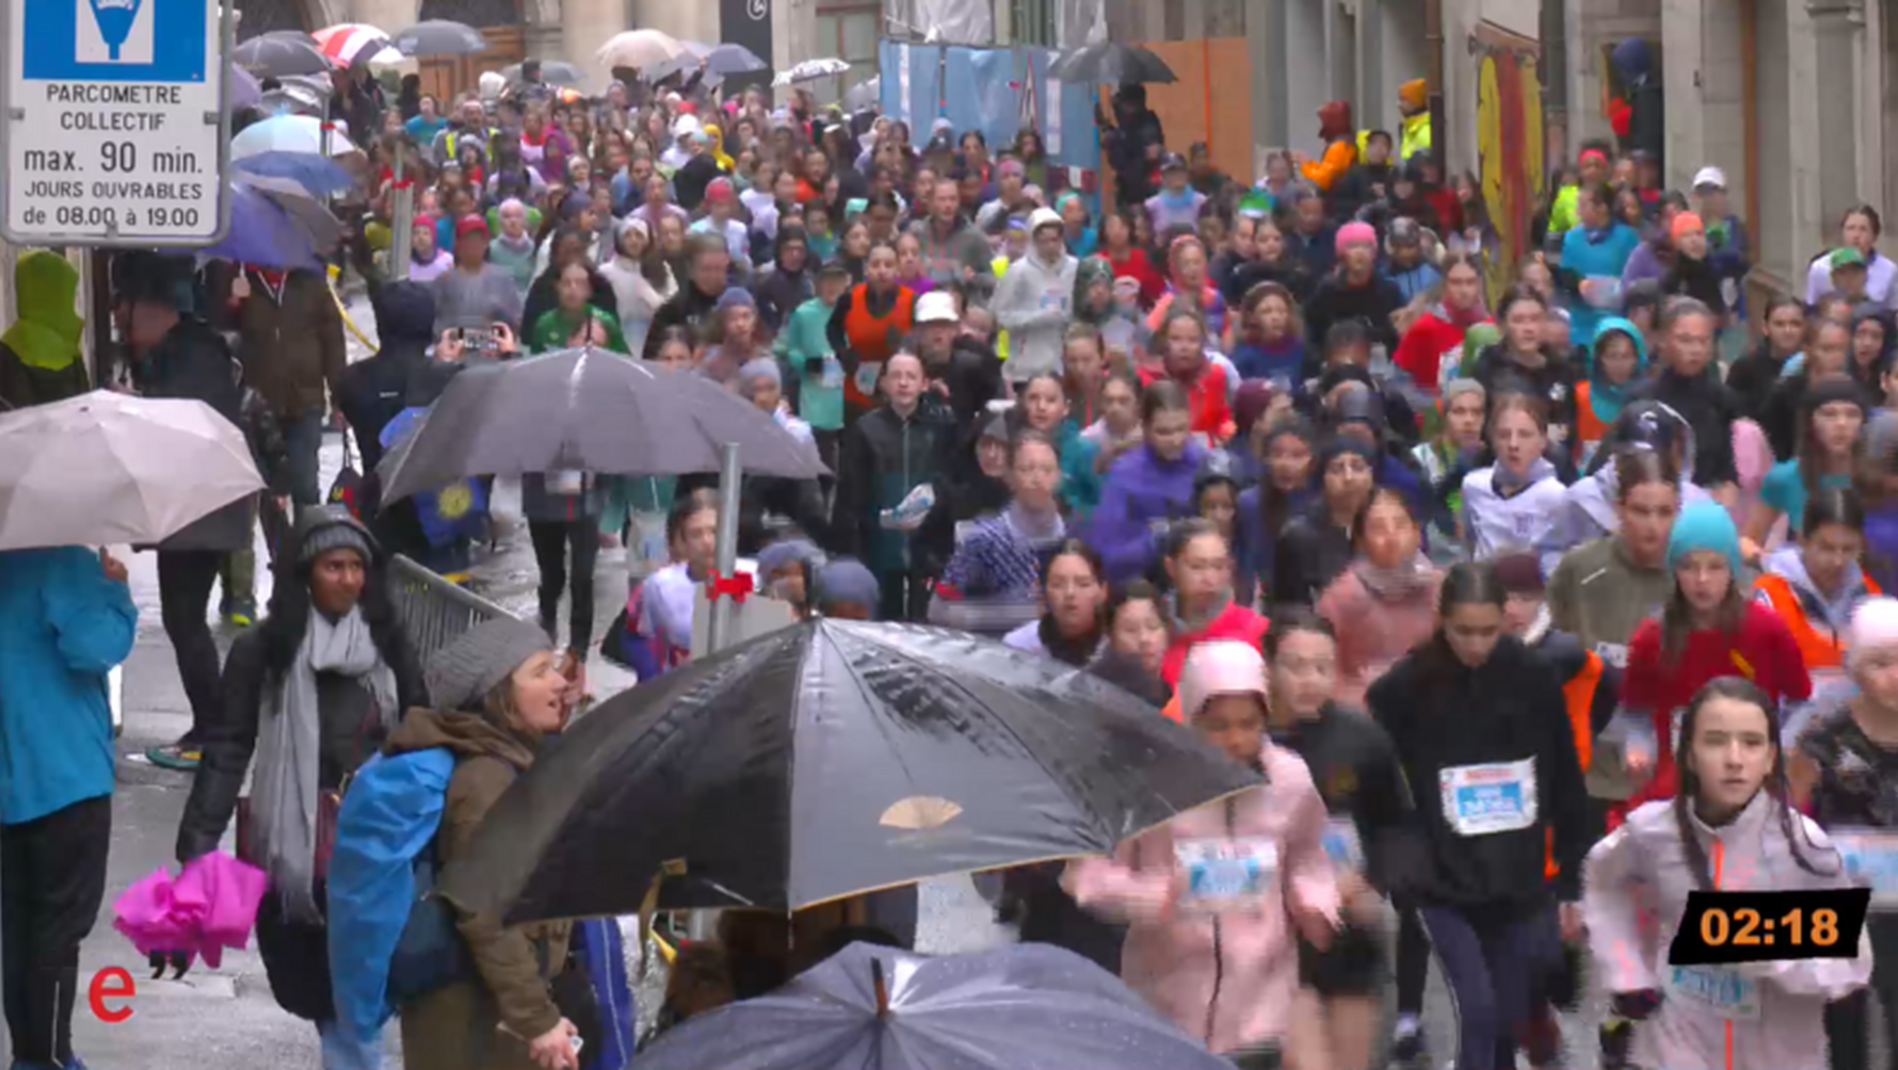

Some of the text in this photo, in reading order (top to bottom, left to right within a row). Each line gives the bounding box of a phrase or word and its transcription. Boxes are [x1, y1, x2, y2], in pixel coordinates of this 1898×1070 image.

[46, 84, 182, 104] PARCOMETRE
[60, 111, 166, 131] COLLECTIF
[24, 141, 203, 174] max. 90 min.
[24, 181, 203, 200] JOURS OUVRABLES
[23, 206, 199, 227] de 08.00 à 19.00
